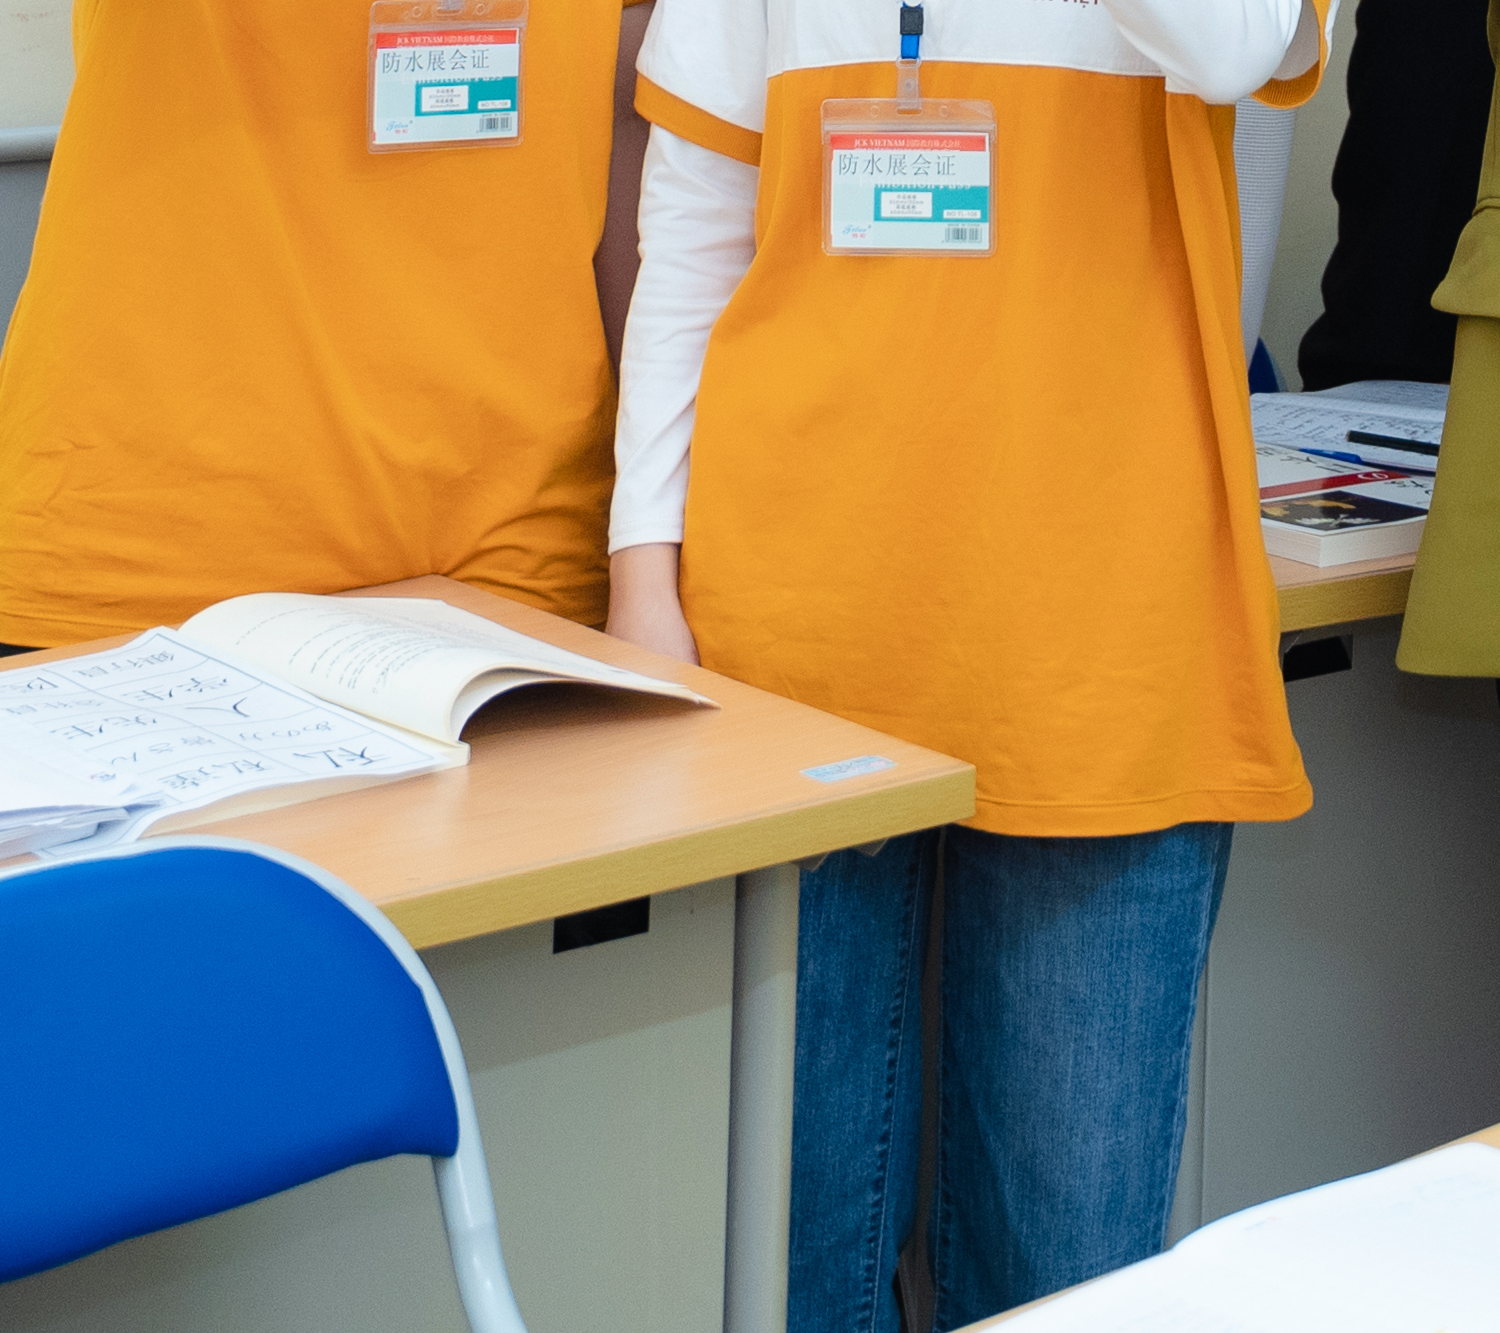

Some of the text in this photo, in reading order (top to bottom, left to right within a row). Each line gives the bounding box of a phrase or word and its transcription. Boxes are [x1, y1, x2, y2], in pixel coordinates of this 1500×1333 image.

[411, 35, 444, 44] VIETNAM
[382, 48, 490, 74] 防水展会证
[854, 139, 868, 147] JCK
[870, 139, 905, 147] VIETNAM
[838, 153, 956, 176] 防水展会证
[121, 675, 227, 701] 学生
[185, 697, 250, 718] 人
[49, 716, 157, 739] 先生
[293, 747, 391, 768] 私
